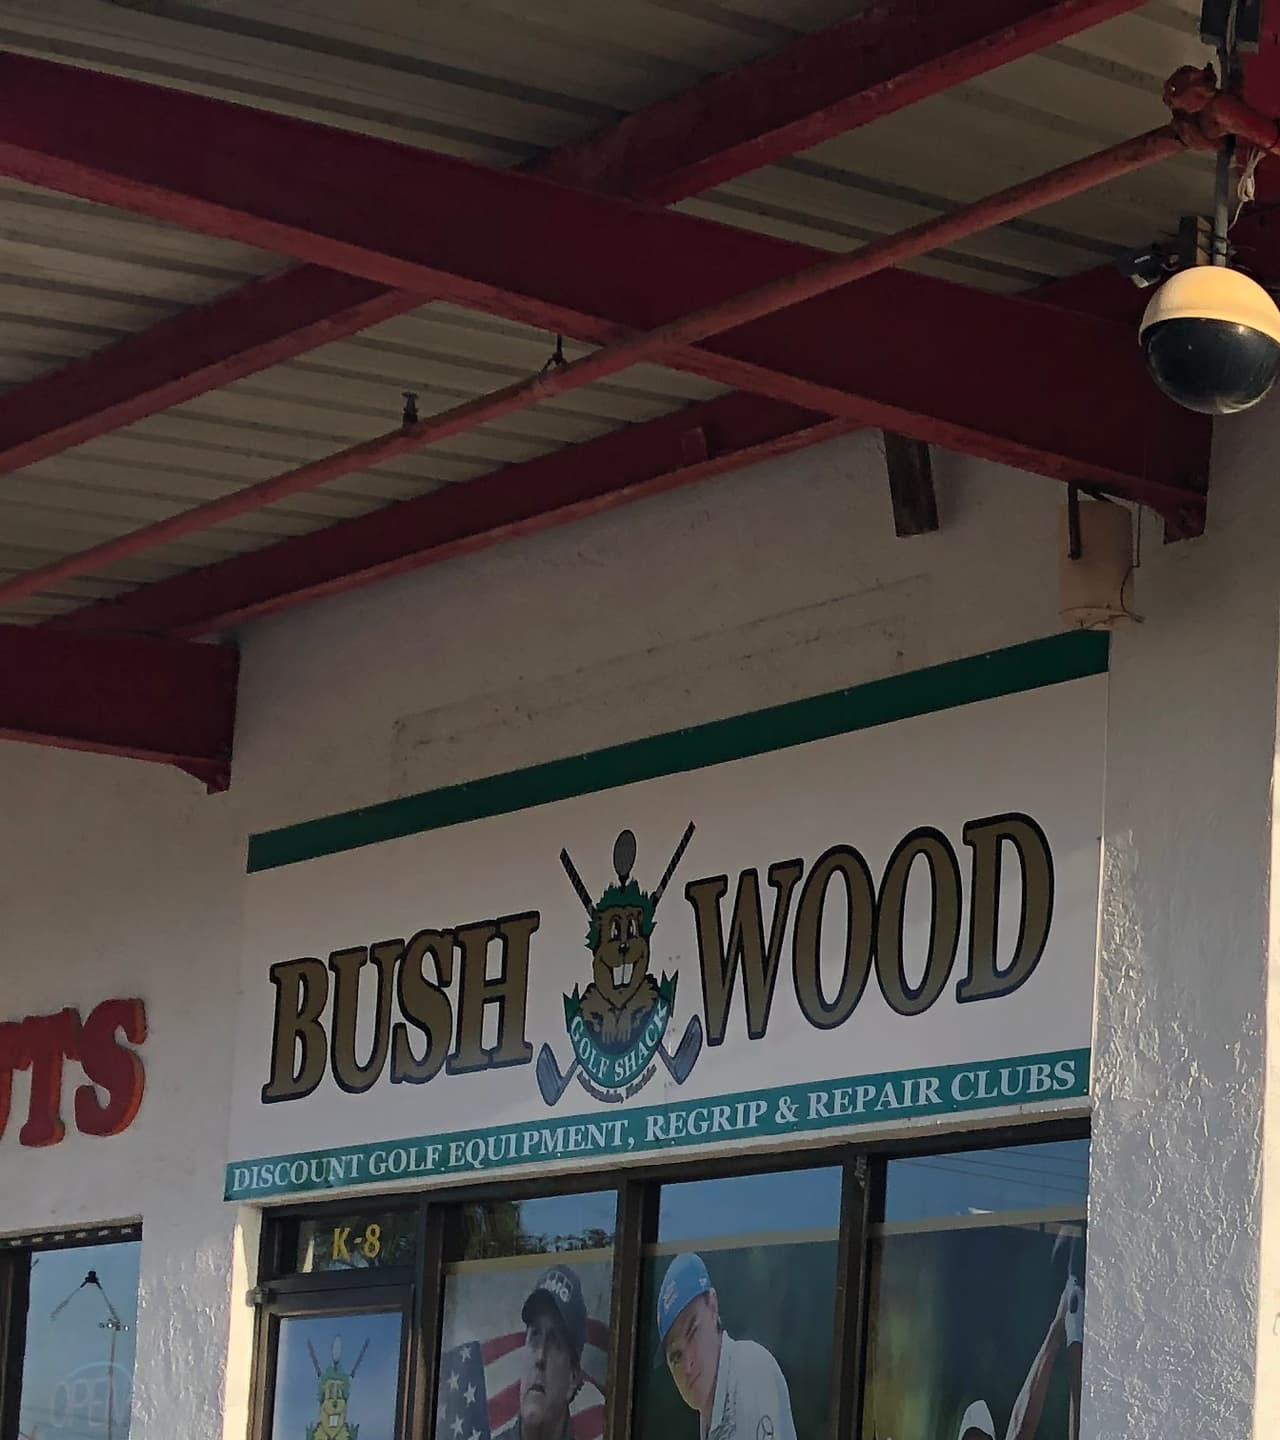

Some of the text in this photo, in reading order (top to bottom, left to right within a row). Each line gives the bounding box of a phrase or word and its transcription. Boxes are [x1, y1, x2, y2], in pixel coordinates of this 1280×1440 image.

[262, 811, 1055, 1104] BUSH WOOD
[570, 1001, 668, 1082] GOLF SHACK
[232, 1060, 1076, 1192] DISCOUNT GOLF EQUIPMENT, REGRIP & REPAIR CLUBS
[331, 1223, 382, 1260] K-8
